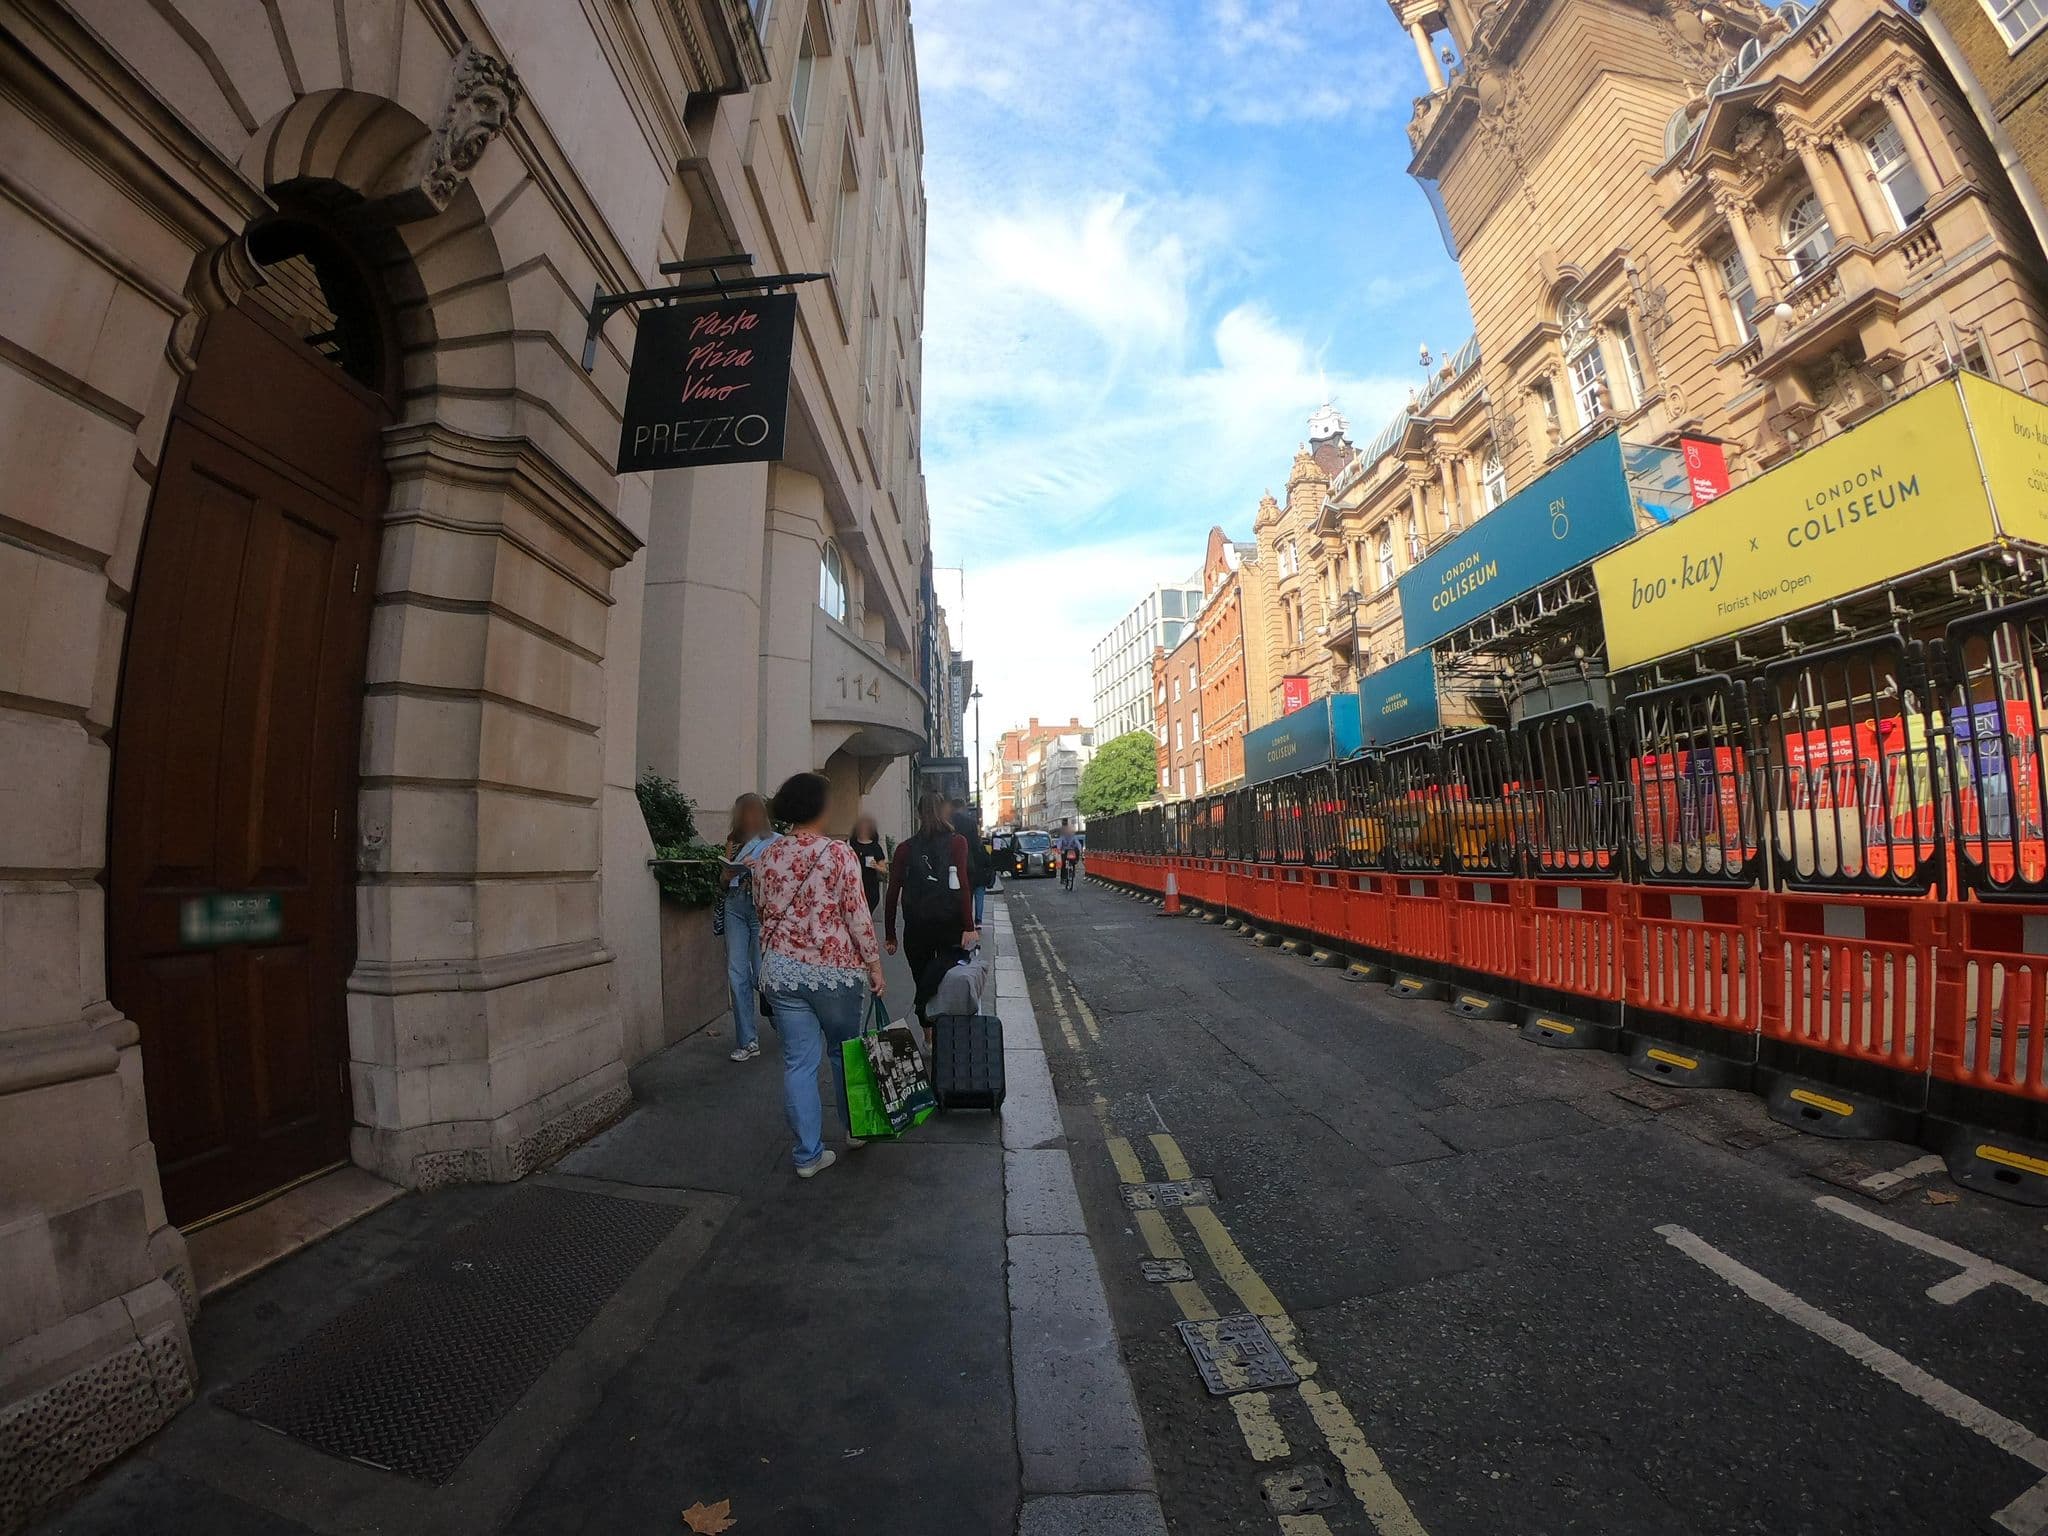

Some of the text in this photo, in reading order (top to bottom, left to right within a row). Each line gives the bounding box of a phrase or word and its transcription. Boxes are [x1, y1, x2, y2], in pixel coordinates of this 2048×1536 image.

[689, 309, 760, 341] Pasta
[685, 341, 755, 371] Pizza
[682, 374, 750, 403] Vino
[634, 414, 769, 456] PREZZO
[1805, 464, 1883, 511] LONDON
[1787, 474, 1920, 548] COLISEUM
[1441, 551, 1480, 585] LONDON
[1432, 560, 1498, 612] COLISEUM
[1717, 574, 1812, 616] Florist Now Open
[1381, 698, 1408, 716] COLISEUM
[1267, 742, 1297, 762] COLISEUM
